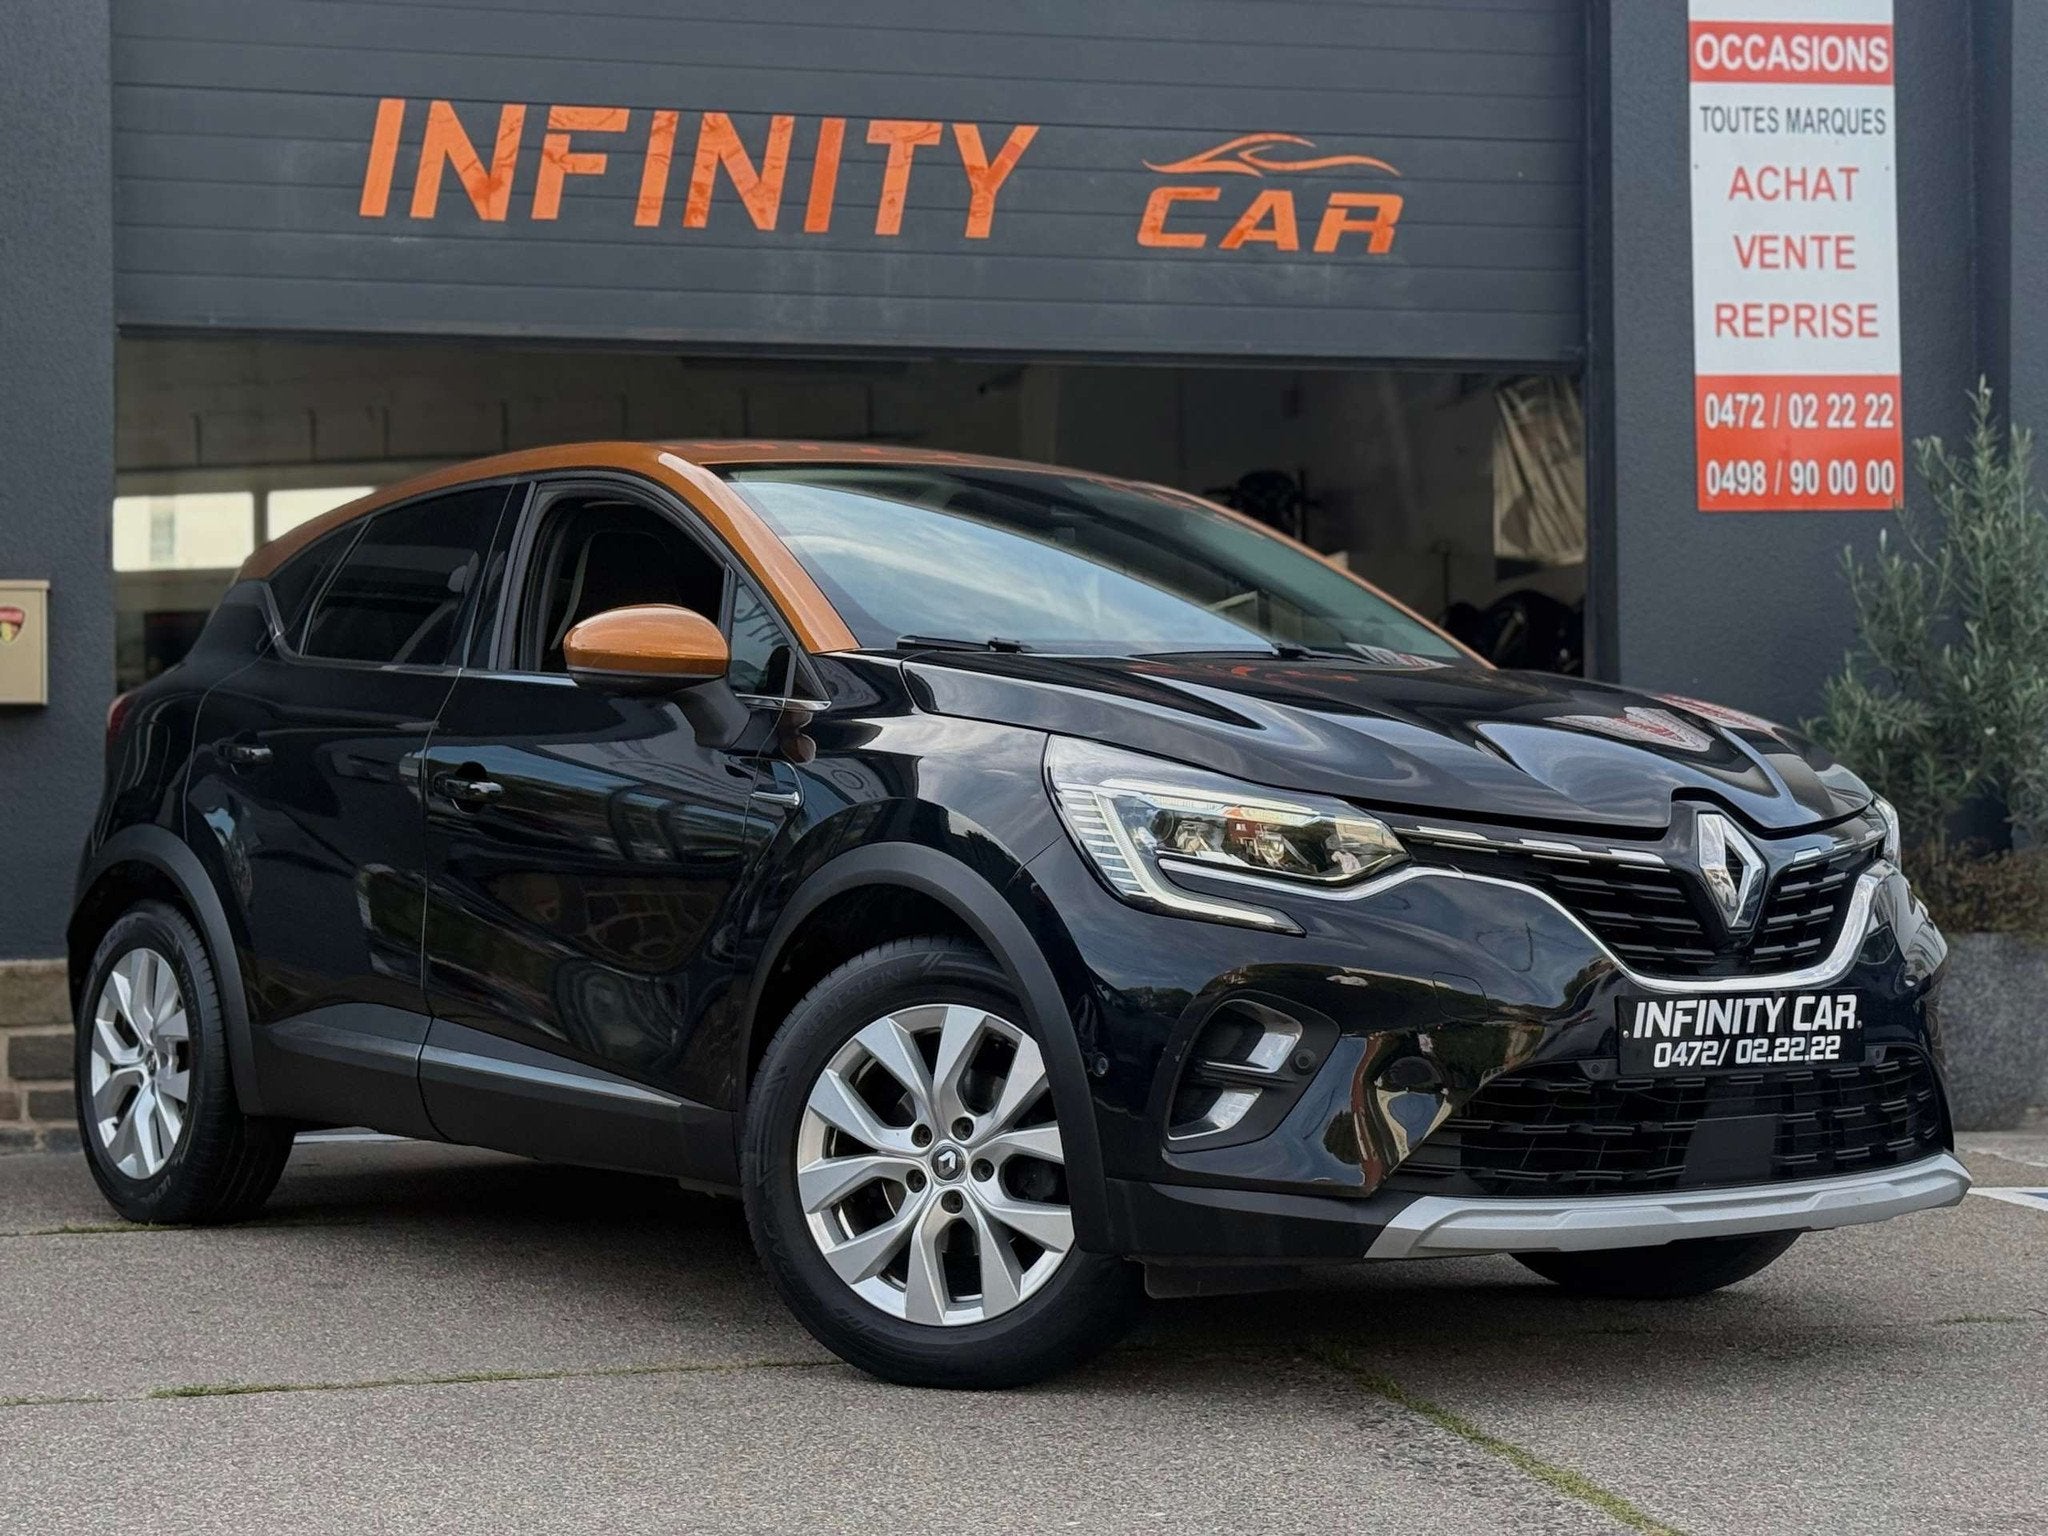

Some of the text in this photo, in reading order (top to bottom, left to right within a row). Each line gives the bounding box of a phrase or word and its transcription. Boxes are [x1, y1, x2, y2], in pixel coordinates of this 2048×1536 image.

[1695, 33, 1890, 74] OCCASIONS
[1700, 105, 1887, 136] TOUTES MARQUES
[358, 97, 1404, 255] INFINITY CAR
[1728, 166, 1860, 202] ACHAT
[1733, 235, 1857, 270] VENTE
[1714, 304, 1879, 339] REPRISE
[1704, 393, 1766, 429] 0472
[1788, 393, 1819, 429] 02
[1826, 393, 1856, 429] 22
[1864, 393, 1895, 429] 22
[1705, 459, 1767, 496] 0498
[1789, 459, 1820, 496] 90
[1827, 459, 1857, 496] 00
[1865, 459, 1896, 496] 00
[1632, 994, 1858, 1039] INFINITY CAR
[1653, 1035, 1840, 1068] 0472/ 02.22.22
